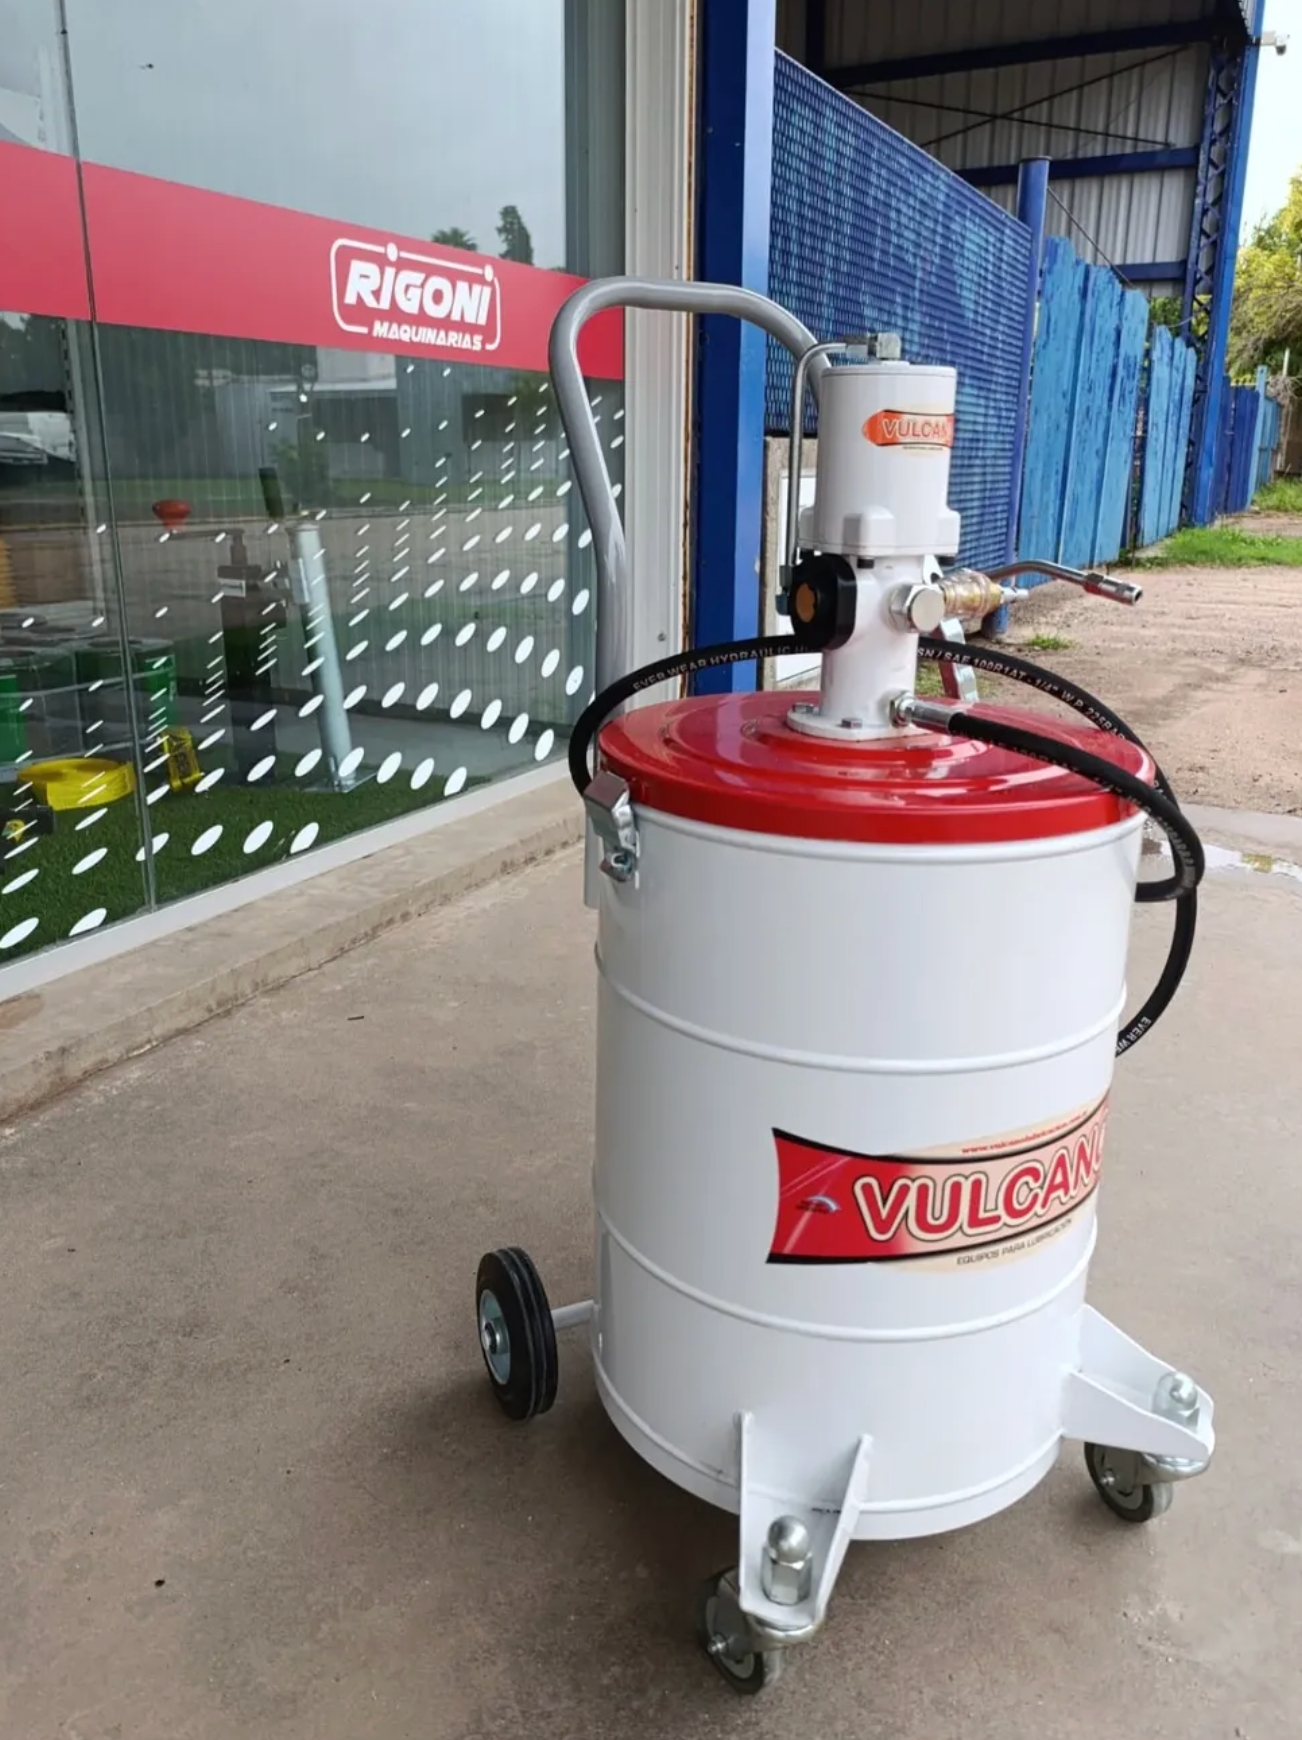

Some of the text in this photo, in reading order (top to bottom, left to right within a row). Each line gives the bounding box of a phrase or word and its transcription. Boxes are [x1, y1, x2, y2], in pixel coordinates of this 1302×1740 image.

[344, 258, 492, 326] RIGONI
[372, 319, 483, 351] MAQUINARIAS
[944, 651, 972, 664] SAE
[632, 672, 666, 691] EVER
[667, 660, 707, 678] WEAR
[956, 1248, 1000, 1265] EQUIPOS
[1001, 1241, 1026, 1256] PARA
